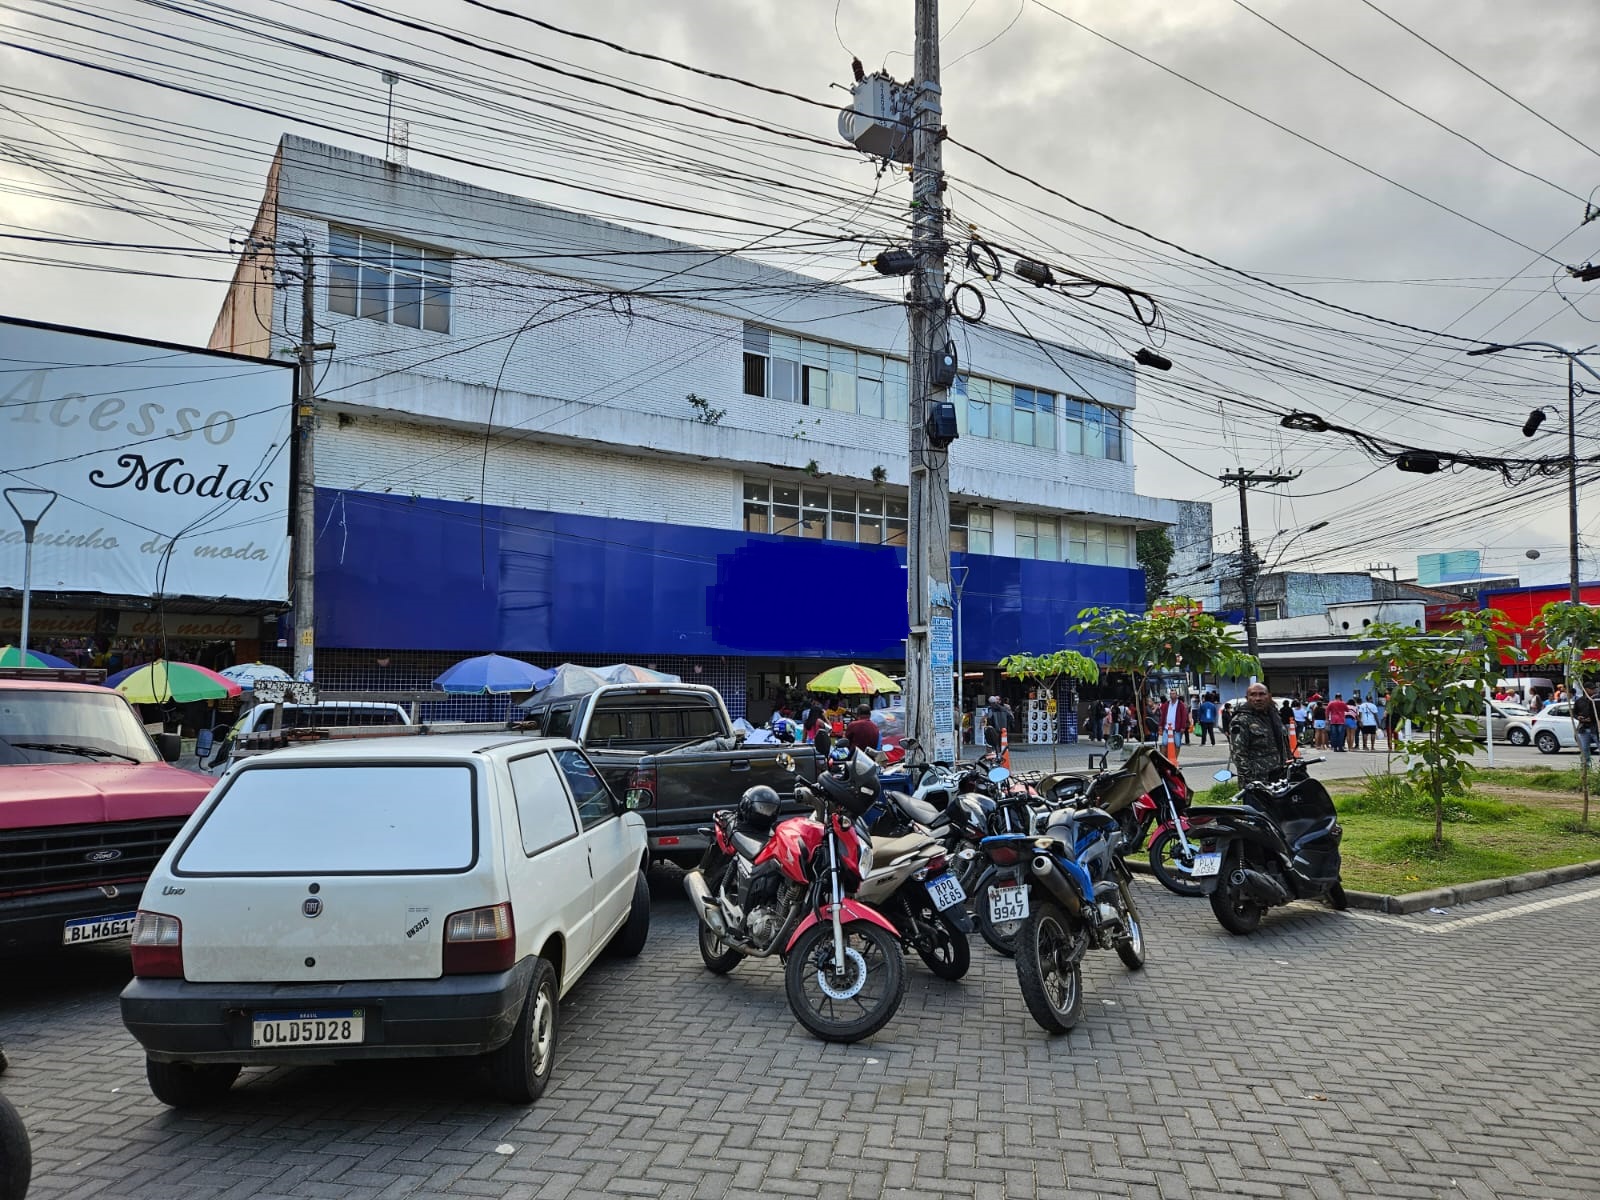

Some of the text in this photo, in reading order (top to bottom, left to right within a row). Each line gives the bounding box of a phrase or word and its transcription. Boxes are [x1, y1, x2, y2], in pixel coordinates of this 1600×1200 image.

[0, 368, 236, 446] Acesso
[89, 453, 274, 503] Modas
[193, 541, 270, 561] moda
[177, 615, 244, 636] moda
[162, 886, 185, 896] Uno
[994, 890, 1023, 908] PLC
[994, 904, 1025, 920] 9947
[263, 1020, 352, 1043] OLD5D28
